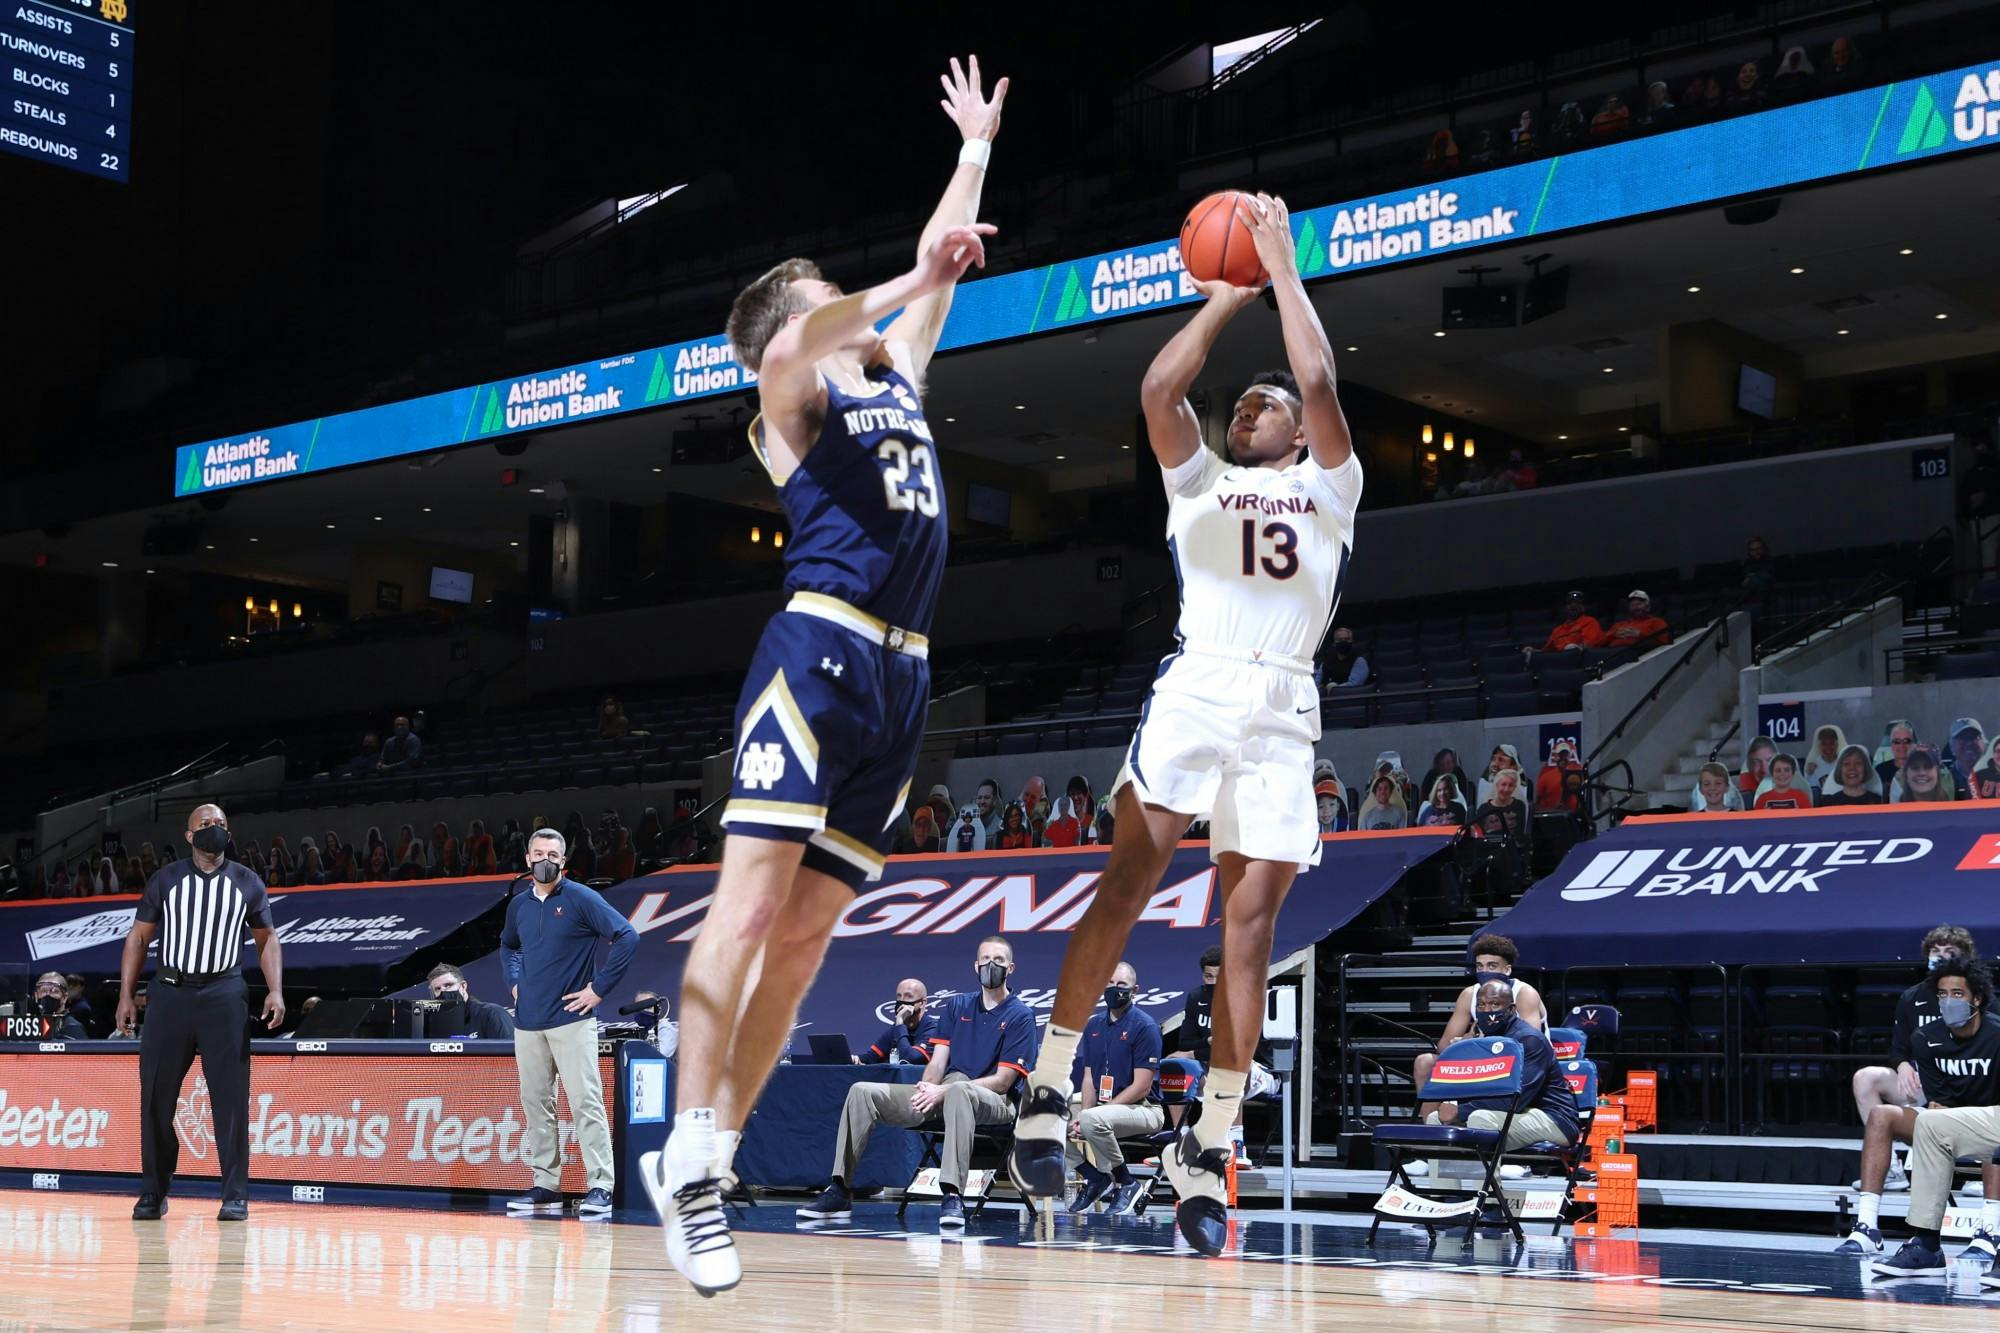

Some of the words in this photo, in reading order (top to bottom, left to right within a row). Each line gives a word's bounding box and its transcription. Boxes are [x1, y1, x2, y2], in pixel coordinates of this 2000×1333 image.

[16, 7, 72, 34] ASSISTS
[110, 32, 120, 47] 5
[0, 33, 86, 69] TURNOVERS
[109, 63, 118, 77] 5
[13, 68, 70, 95] BLOCKS
[109, 93, 115, 108] 1
[14, 100, 67, 126] STEALS
[106, 125, 116, 139] 4
[0, 128, 78, 160] REBOUNDS
[100, 153, 119, 170] 22
[1330, 189, 1458, 239] Atlantic
[1329, 230, 1422, 268] Union
[1429, 206, 1516, 249] Bank
[1091, 245, 1186, 288] Atlant
[1091, 280, 1173, 314] Union
[674, 343, 734, 373] Atlan
[507, 370, 587, 405] Atlantic
[674, 366, 738, 396] Union
[506, 401, 564, 428] Union
[568, 386, 622, 417] Bank
[843, 407, 910, 436] NOTRE
[204, 435, 270, 466] Atlantic
[203, 463, 251, 487] Union
[254, 451, 298, 478] Bank
[878, 438, 940, 518] 23
[1920, 459, 1947, 477] 103
[1216, 493, 1319, 517] VIRGINIA
[1242, 519, 1299, 581] 13
[1102, 564, 1120, 578] 102
[1766, 717, 1800, 739] 104
[1665, 837, 1934, 872] UNITED
[1633, 868, 1841, 897] BANK
[37, 927, 133, 939] DIAMON
[83, 915, 131, 927] RED
[300, 915, 405, 931] Atlantic
[350, 927, 427, 941] Bank
[6, 1017, 42, 1037] POSS.
[39, 1043, 65, 1051] GEICO
[296, 1041, 327, 1051] GEICO
[430, 1042, 463, 1053] GEICO
[1440, 1066, 1473, 1075] WELLS
[1475, 1062, 1506, 1074] FARGO
[1935, 1057, 1992, 1076] UNITY
